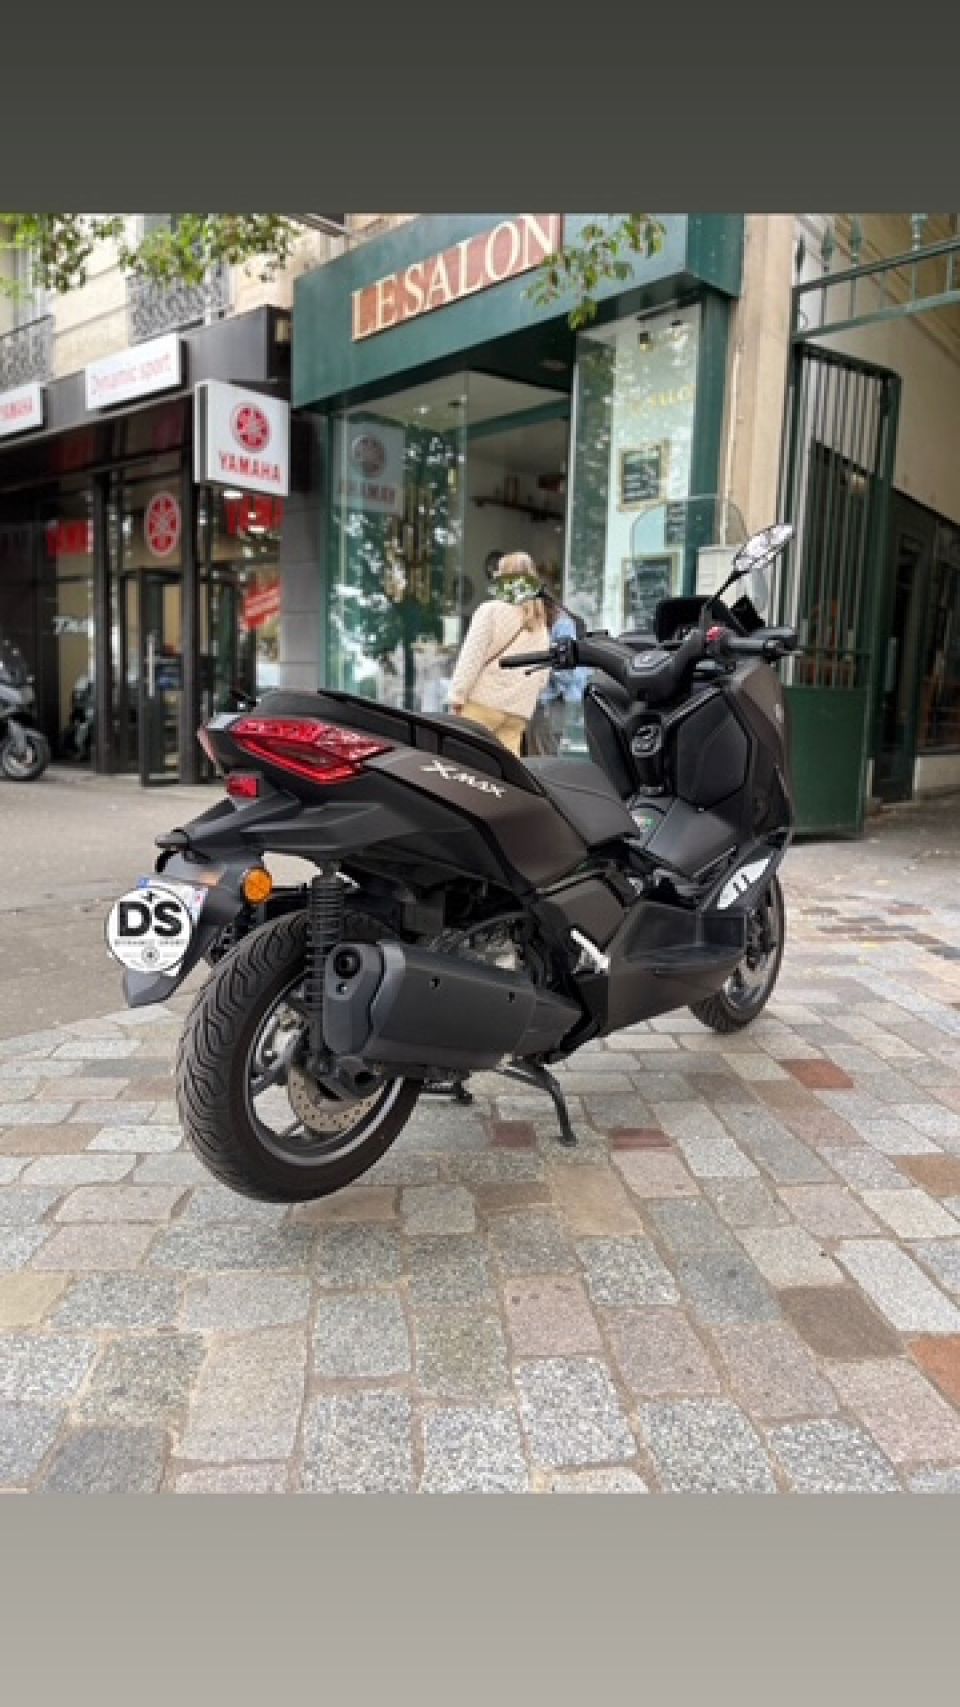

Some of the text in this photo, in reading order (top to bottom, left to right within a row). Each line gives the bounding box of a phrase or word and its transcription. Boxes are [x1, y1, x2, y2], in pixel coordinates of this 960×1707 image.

[351, 213, 560, 341] LE SALON
[218, 451, 281, 483] YAMAHA
